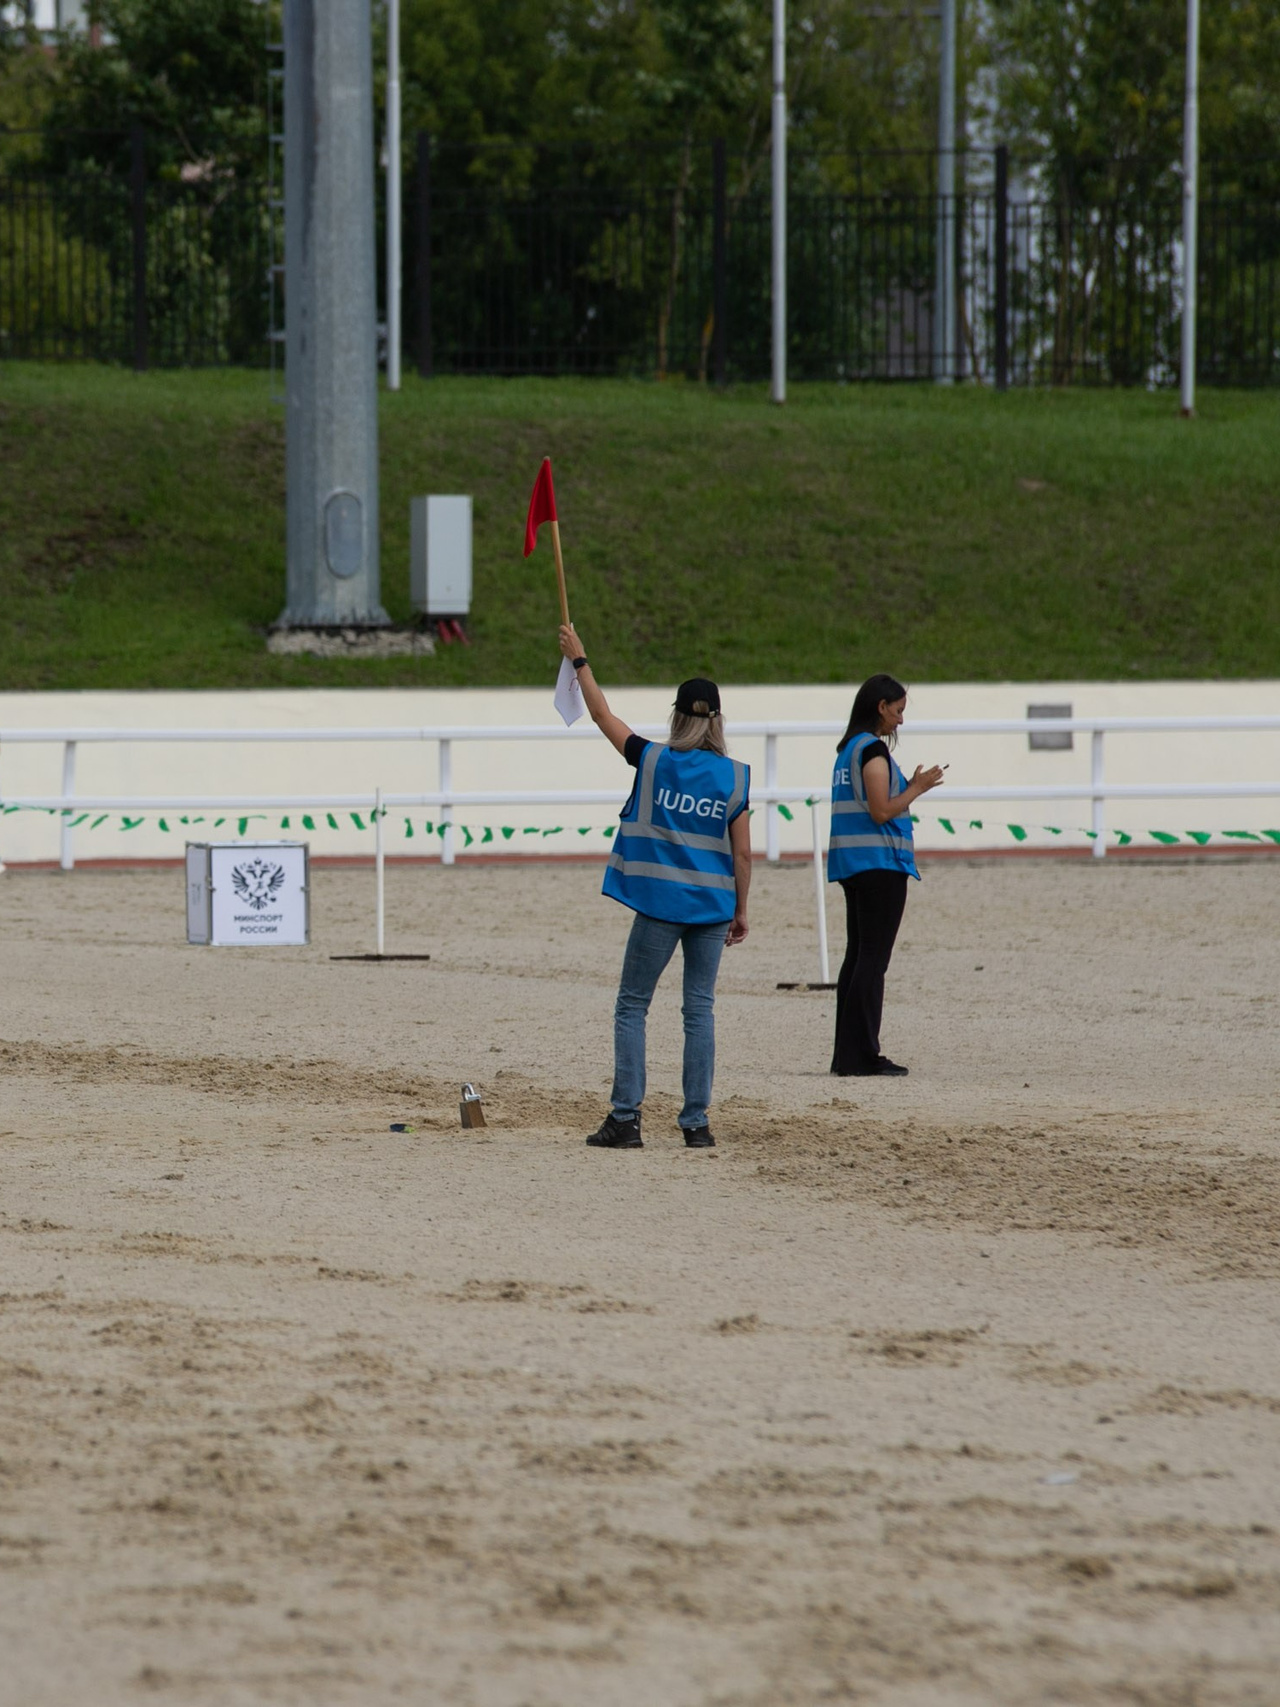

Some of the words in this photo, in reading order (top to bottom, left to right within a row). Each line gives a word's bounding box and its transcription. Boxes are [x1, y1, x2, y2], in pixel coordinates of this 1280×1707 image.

[654, 787, 727, 820] JUDGE
[233, 914, 283, 923] МИНСПОРТ
[239, 926, 278, 934] РОССИИ
